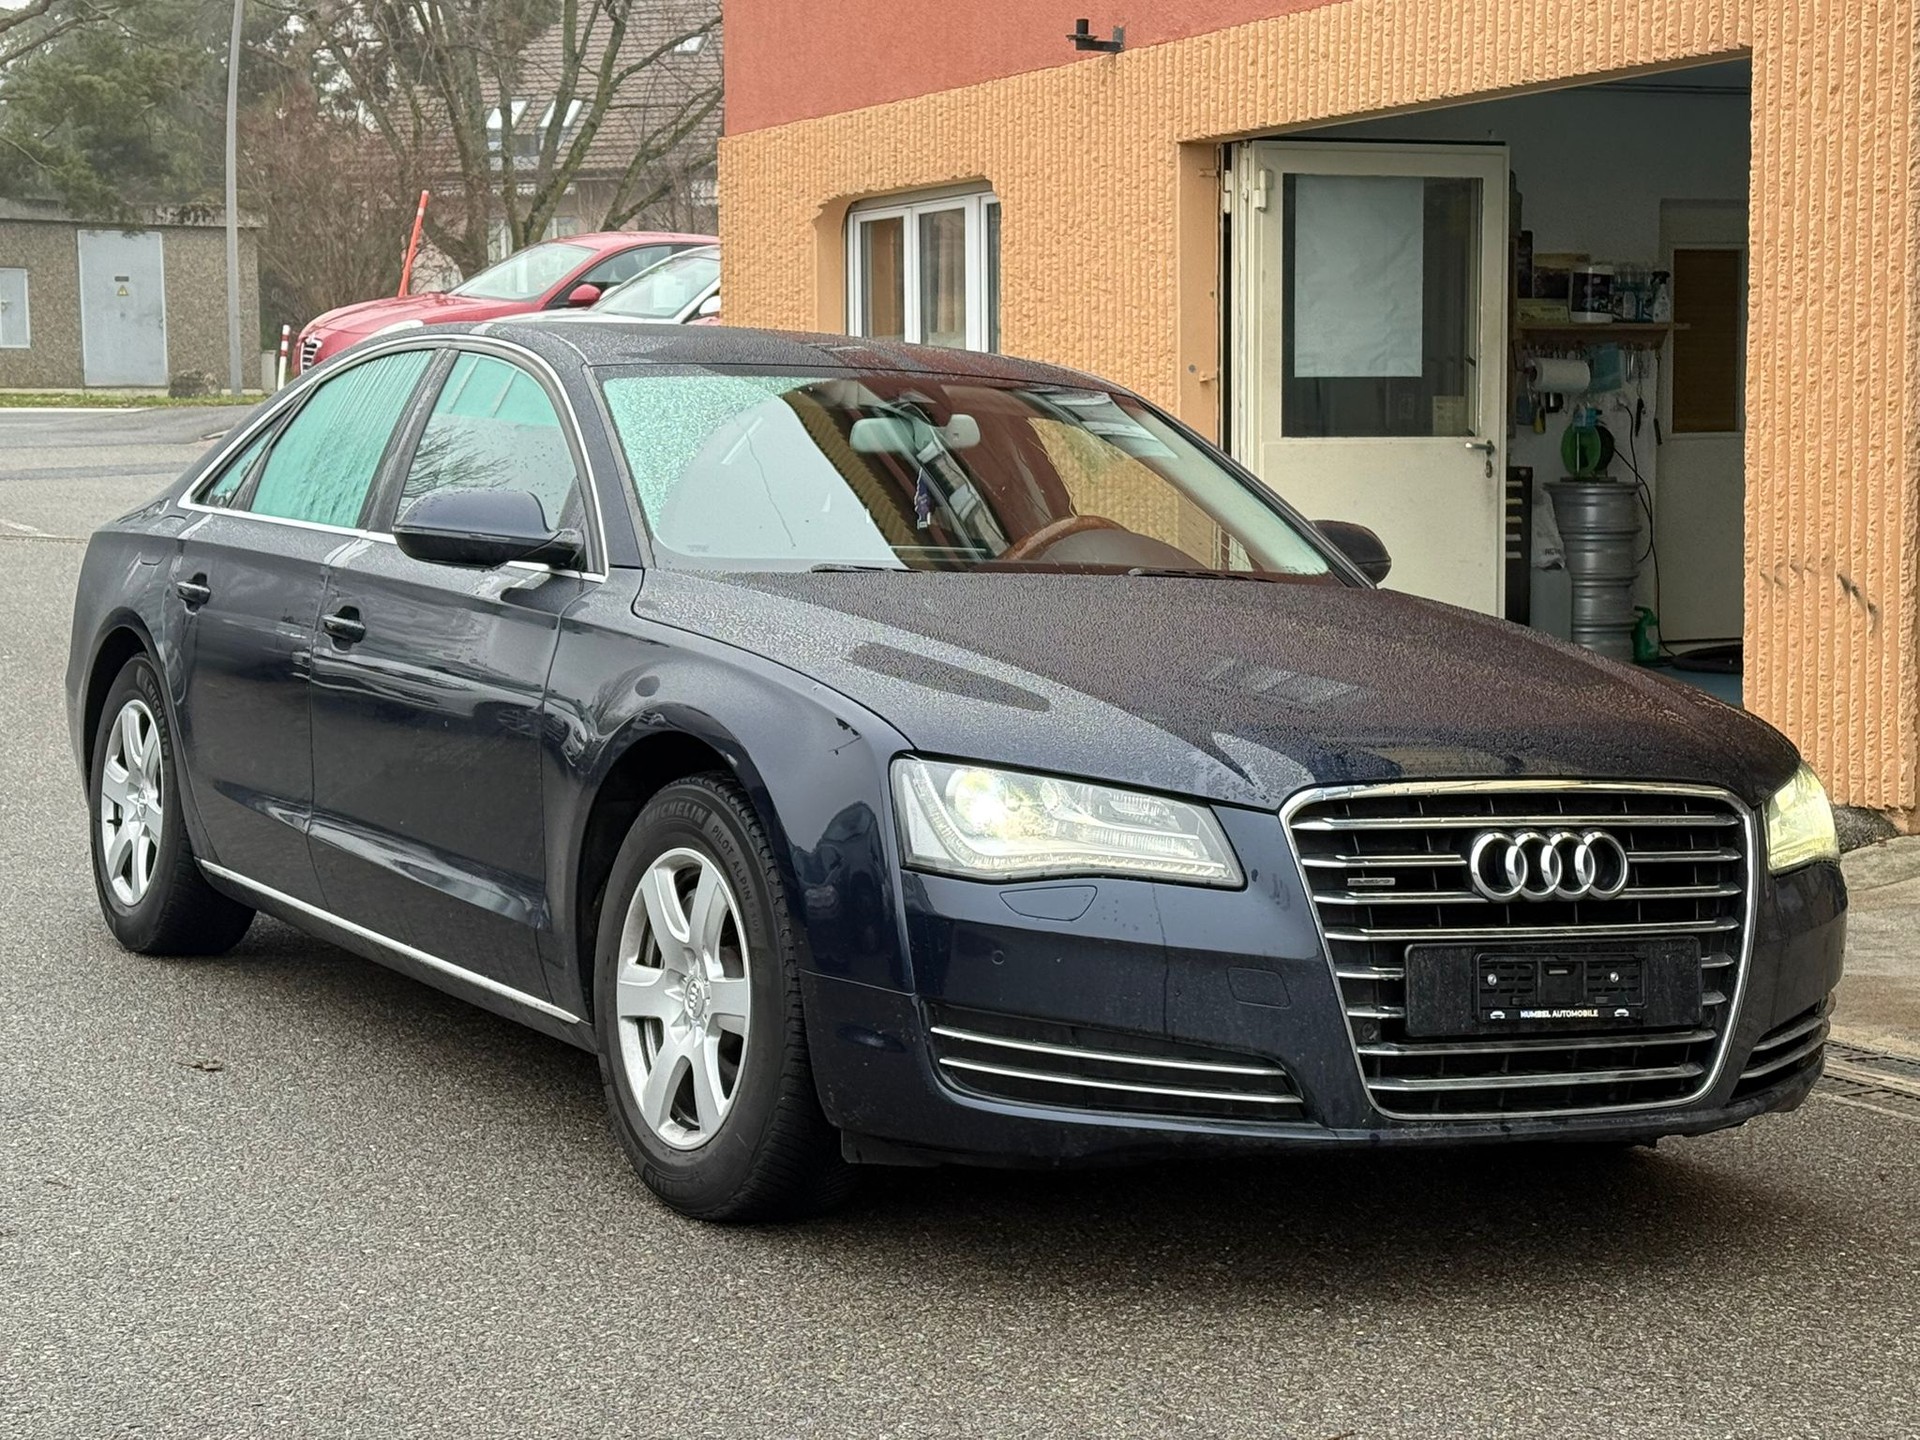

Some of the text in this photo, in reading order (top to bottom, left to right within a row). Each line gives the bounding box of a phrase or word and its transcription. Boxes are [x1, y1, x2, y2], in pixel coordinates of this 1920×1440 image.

[645, 801, 707, 823] MICHELIN
[711, 825, 734, 855] PILOT
[732, 861, 752, 900] ALPIN
[1552, 1009, 1599, 1018] AUTOMOBILE
